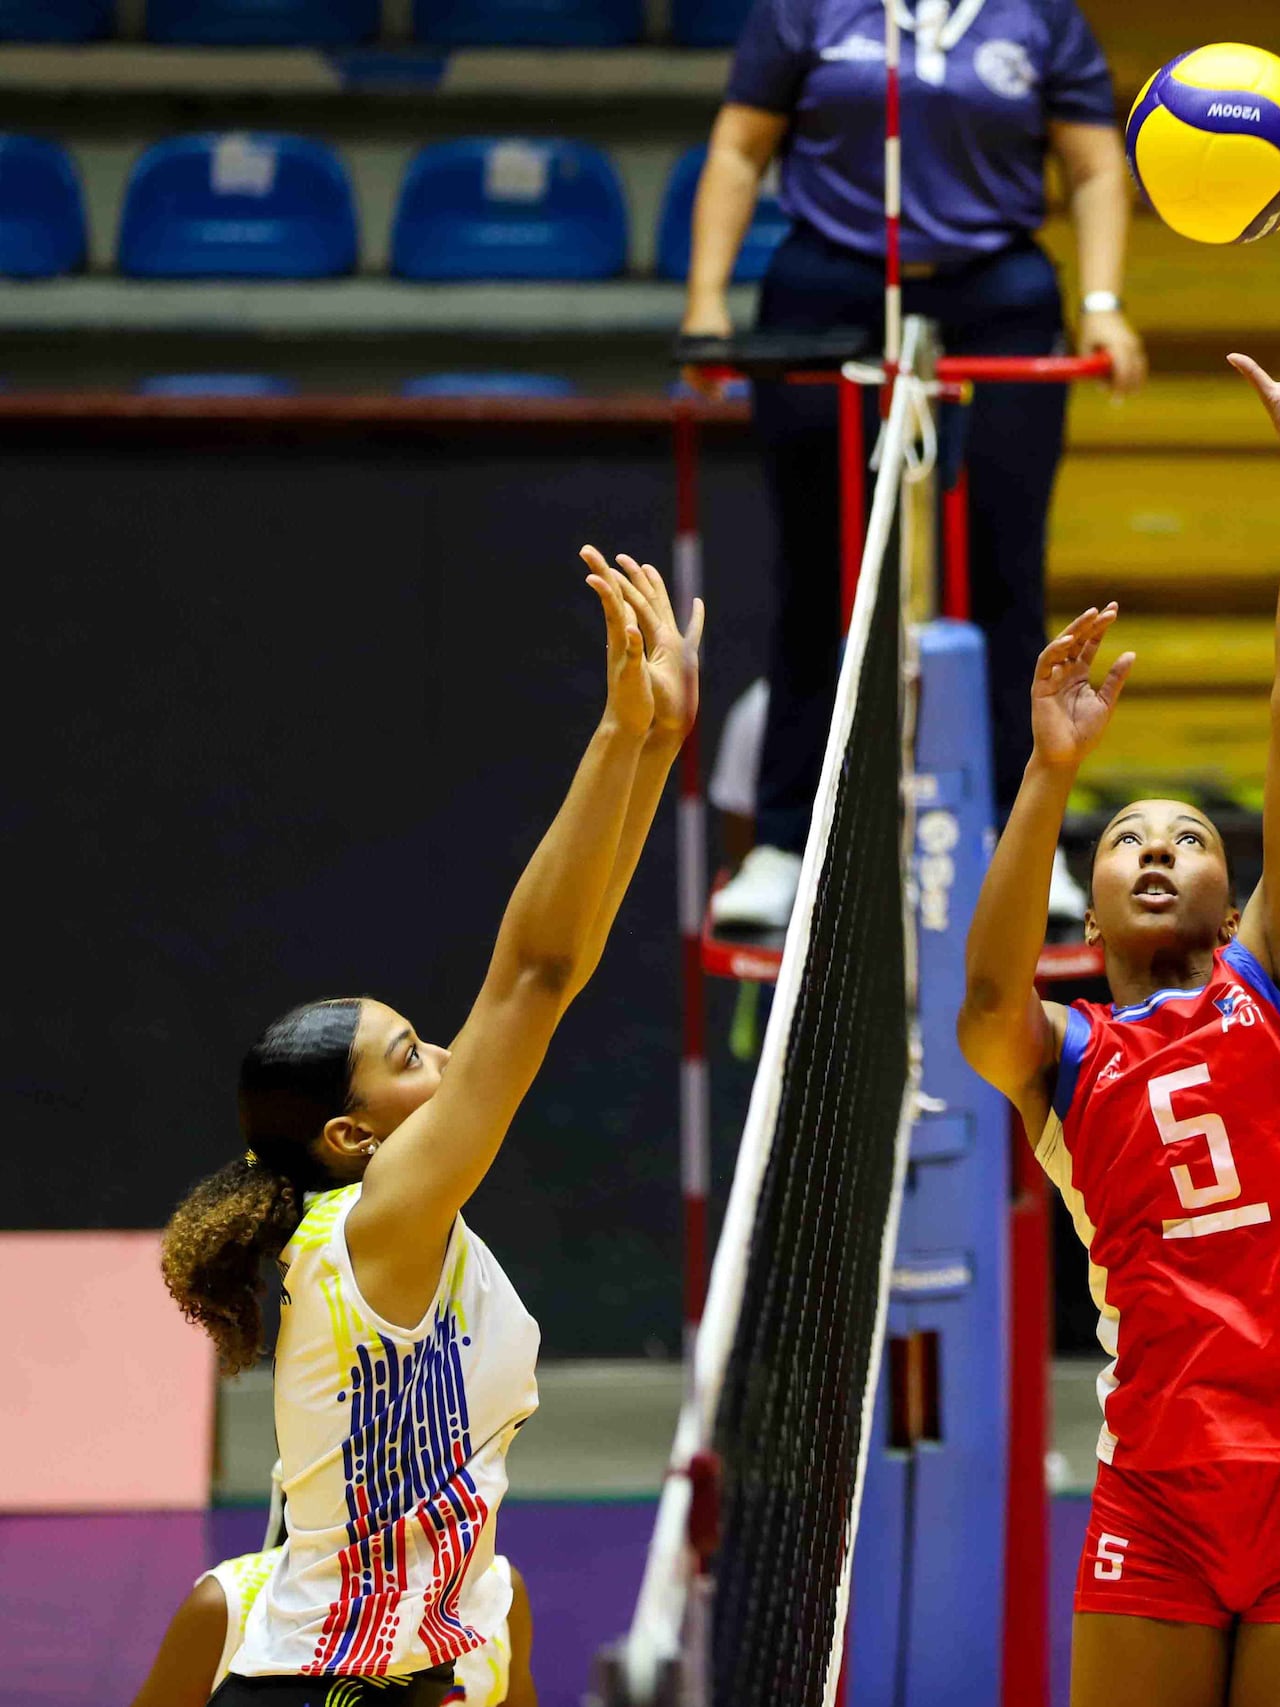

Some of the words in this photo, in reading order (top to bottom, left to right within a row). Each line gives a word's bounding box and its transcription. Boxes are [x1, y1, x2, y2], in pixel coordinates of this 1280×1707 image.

[1207, 103, 1260, 122] V200W
[1148, 1062, 1242, 1210] 5
[1094, 1532, 1129, 1581] 5
